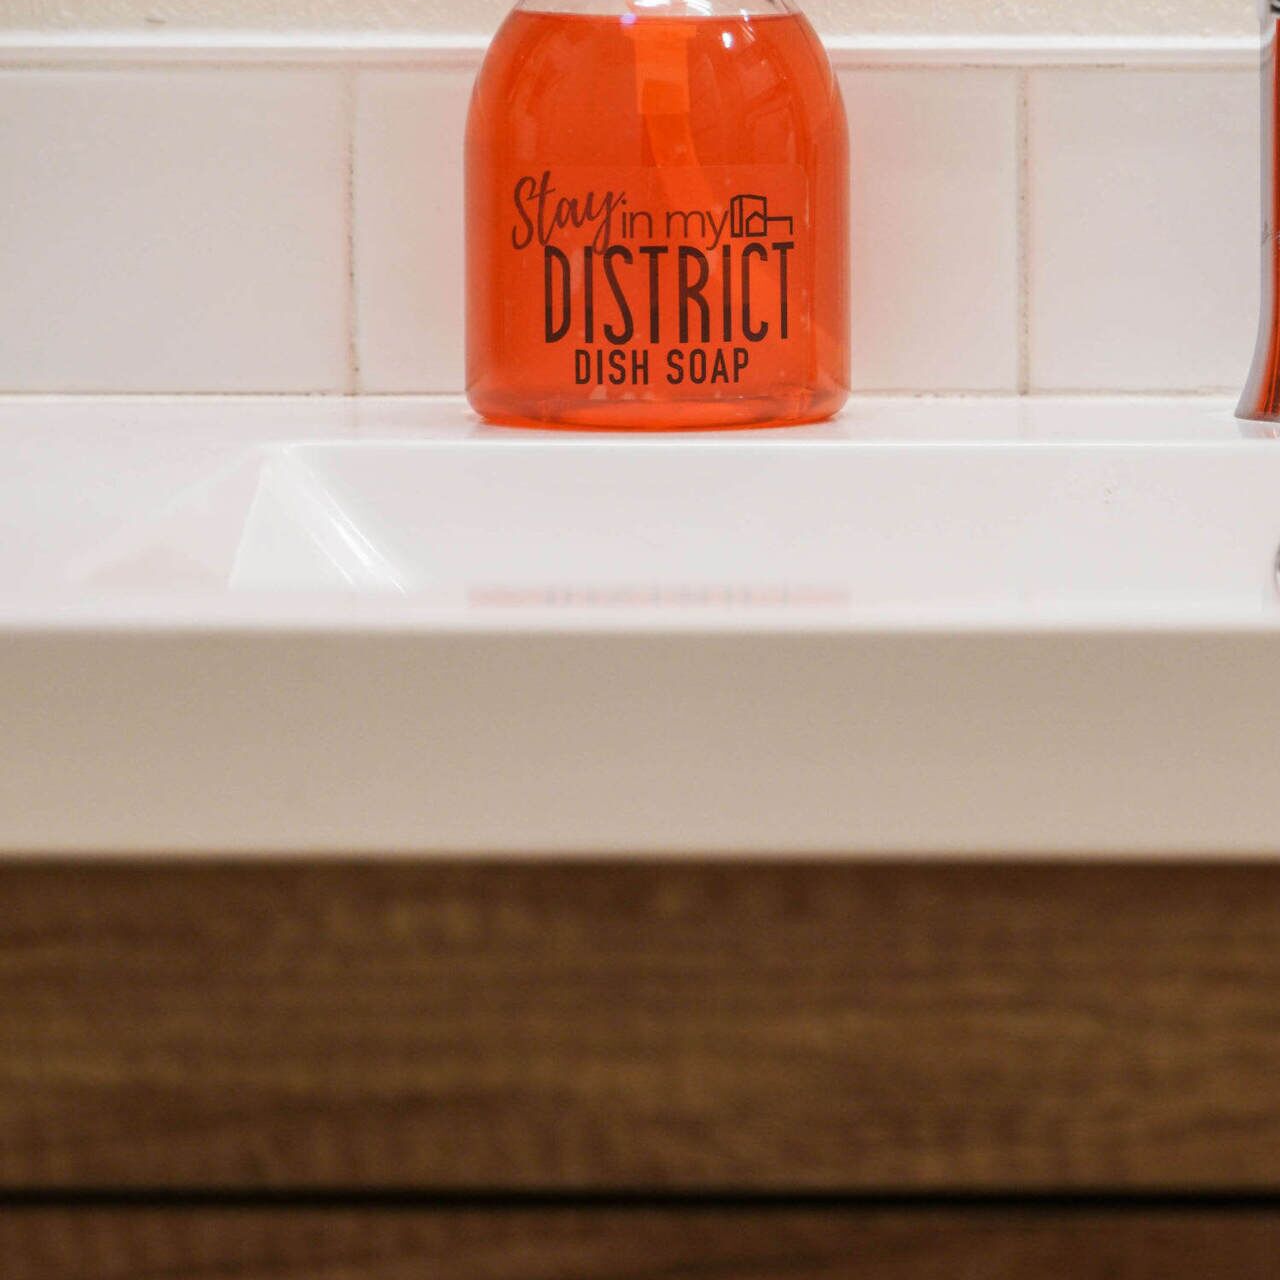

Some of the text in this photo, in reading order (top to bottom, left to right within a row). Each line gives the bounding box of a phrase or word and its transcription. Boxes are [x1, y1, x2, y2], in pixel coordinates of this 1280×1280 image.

[511, 170, 729, 255] Stay in my
[544, 241, 795, 345] DISTRICT
[575, 347, 749, 385] DISH SOAP
